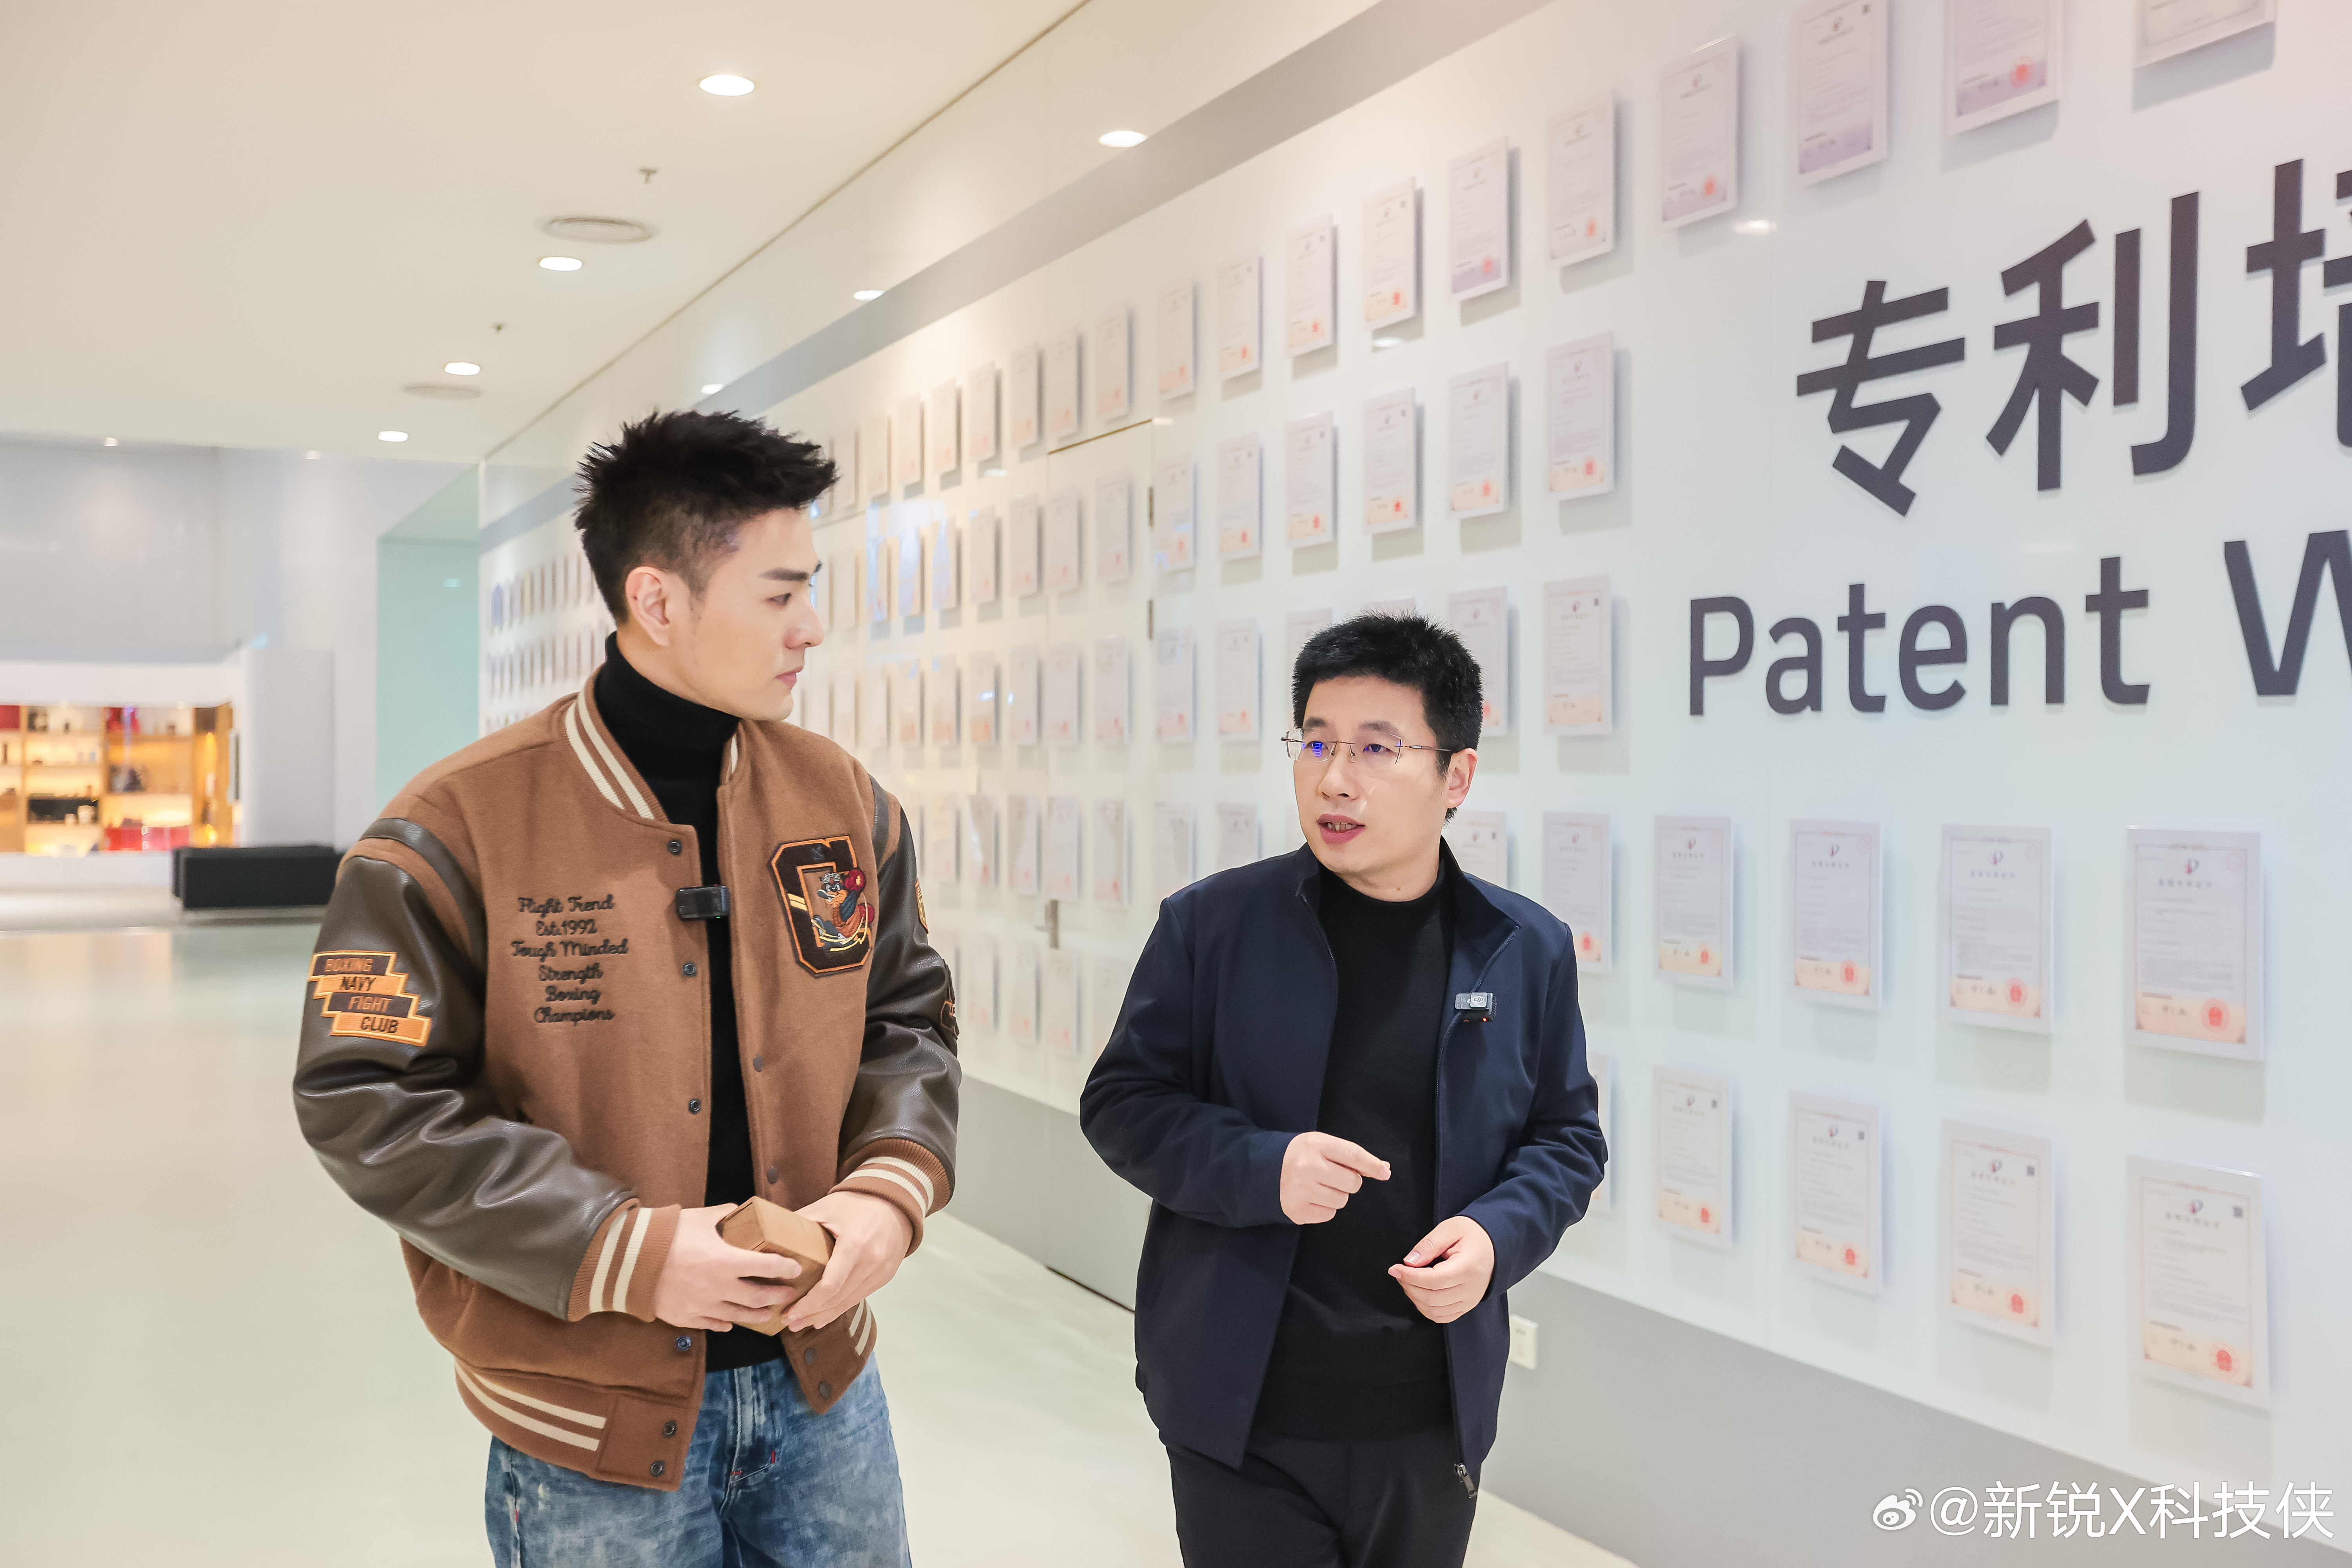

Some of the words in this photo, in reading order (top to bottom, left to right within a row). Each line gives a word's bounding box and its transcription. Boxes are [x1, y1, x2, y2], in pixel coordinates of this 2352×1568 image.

[1690, 556, 2150, 715] Patent
[568, 894, 615, 912] Trend
[511, 941, 557, 963] Tough
[559, 939, 629, 957] Minded
[325, 958, 373, 972] BOXING
[539, 963, 604, 985] Strength
[340, 976, 376, 992] NAVY
[347, 996, 393, 1012] FIGHT
[545, 986, 601, 1005] Boxing
[360, 1016, 399, 1033] CLUB
[534, 1007, 615, 1026] Champions
